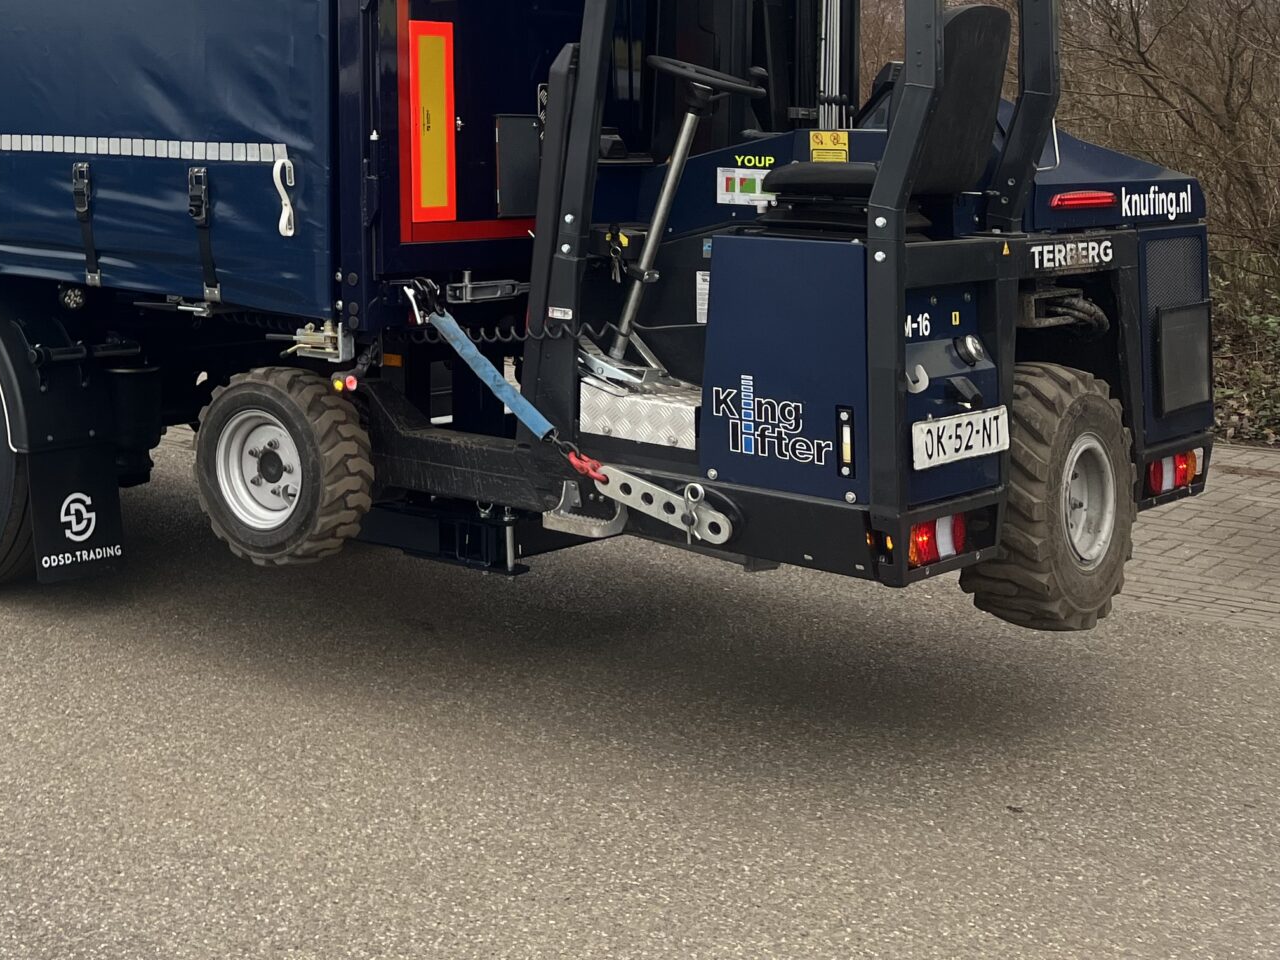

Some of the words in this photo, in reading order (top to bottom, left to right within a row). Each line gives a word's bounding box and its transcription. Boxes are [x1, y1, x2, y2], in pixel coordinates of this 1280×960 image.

[735, 155, 775, 167] YOUP
[1121, 184, 1192, 221] knufing.nl
[1030, 241, 1113, 269] TERBERG
[925, 415, 1000, 460] OK-52-NT
[41, 544, 122, 568] ODSD-TRADING
